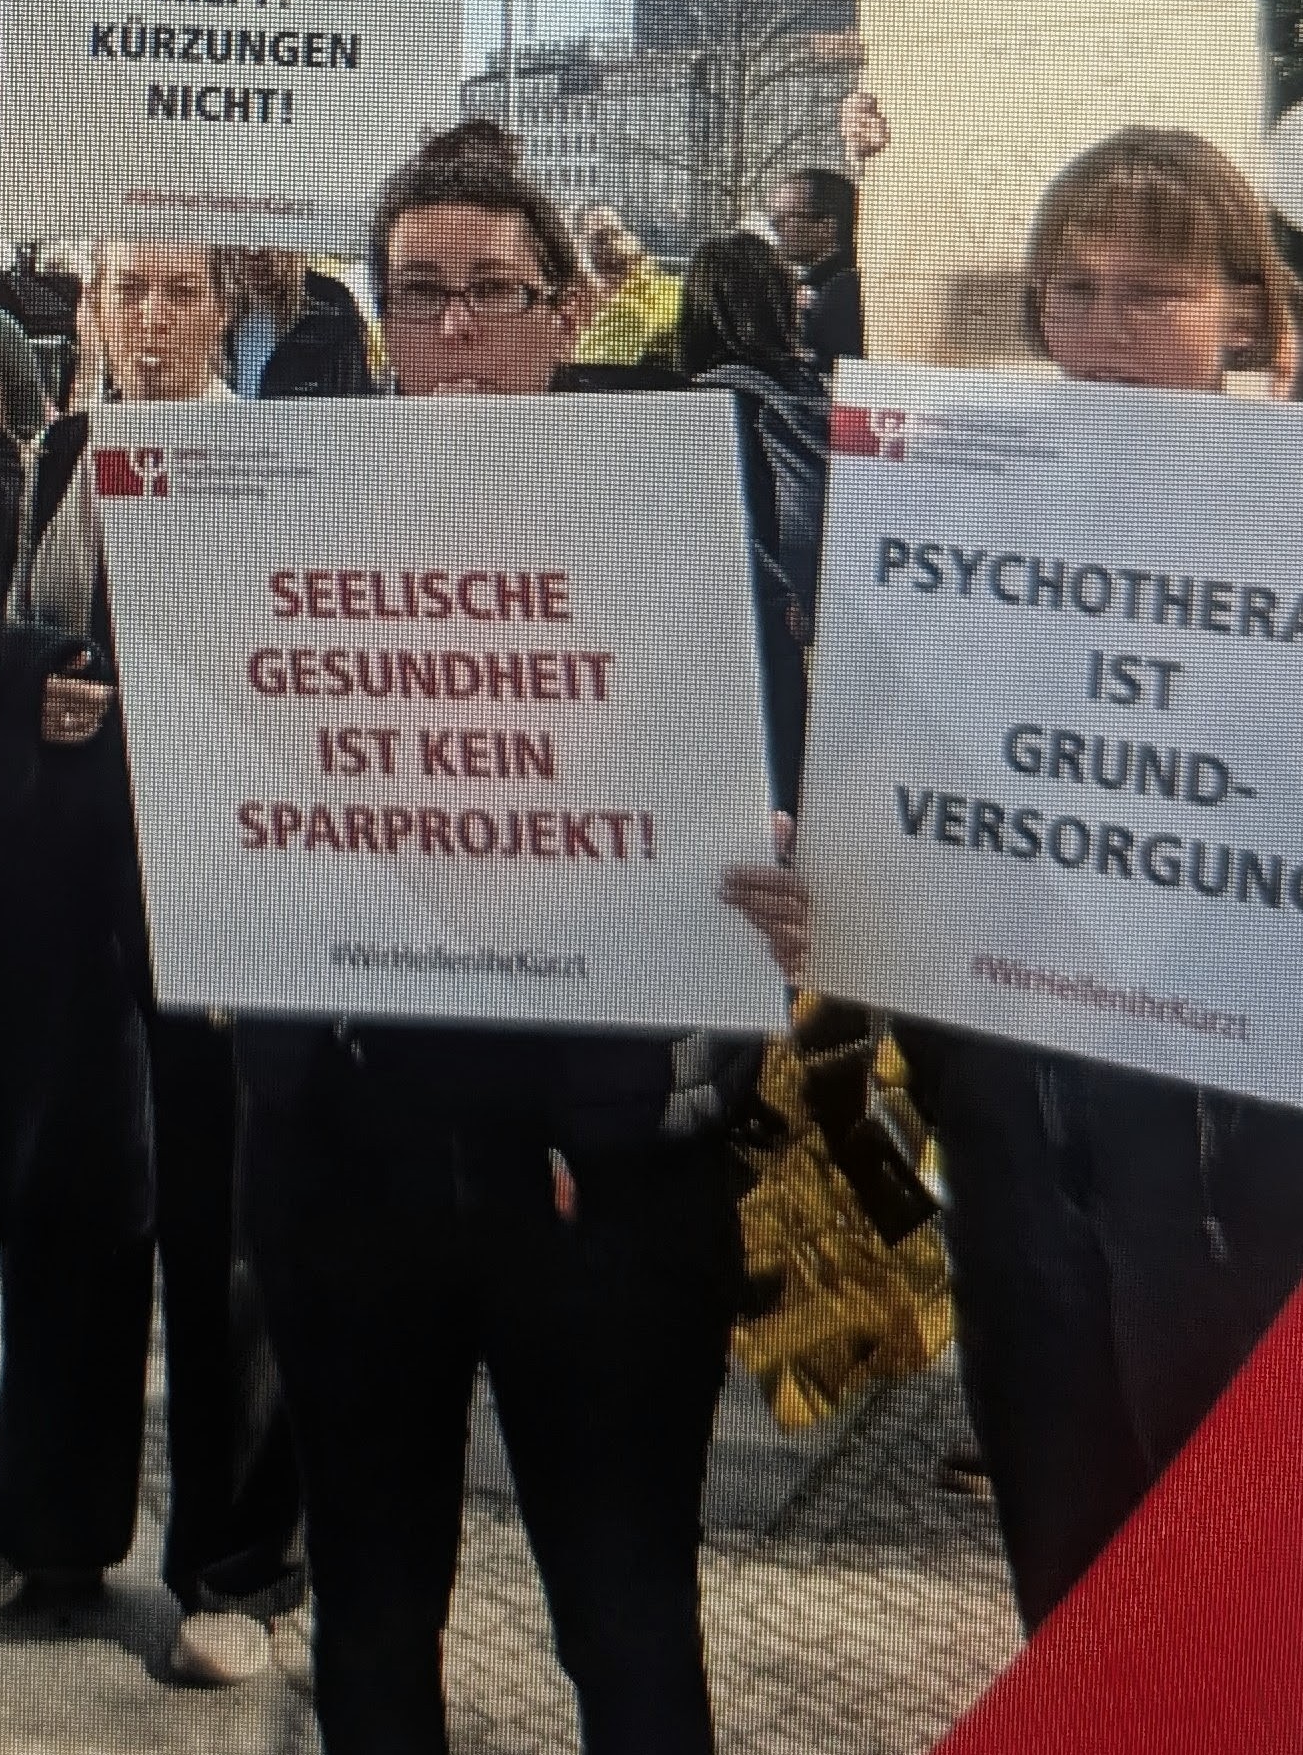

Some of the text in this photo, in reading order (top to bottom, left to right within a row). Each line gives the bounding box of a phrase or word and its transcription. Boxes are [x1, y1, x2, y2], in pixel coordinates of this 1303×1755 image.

[91, 15, 360, 69] KÜRZUNGEN
[146, 84, 294, 124] NICHT!
[269, 569, 569, 622] SEELISCHE
[247, 647, 613, 702] GESUNDHEIT
[1087, 649, 1182, 711] IST
[317, 728, 554, 780] IST KEIN
[1002, 723, 1258, 807] GRUND-
[237, 800, 656, 859] SPARPROJEKT!
